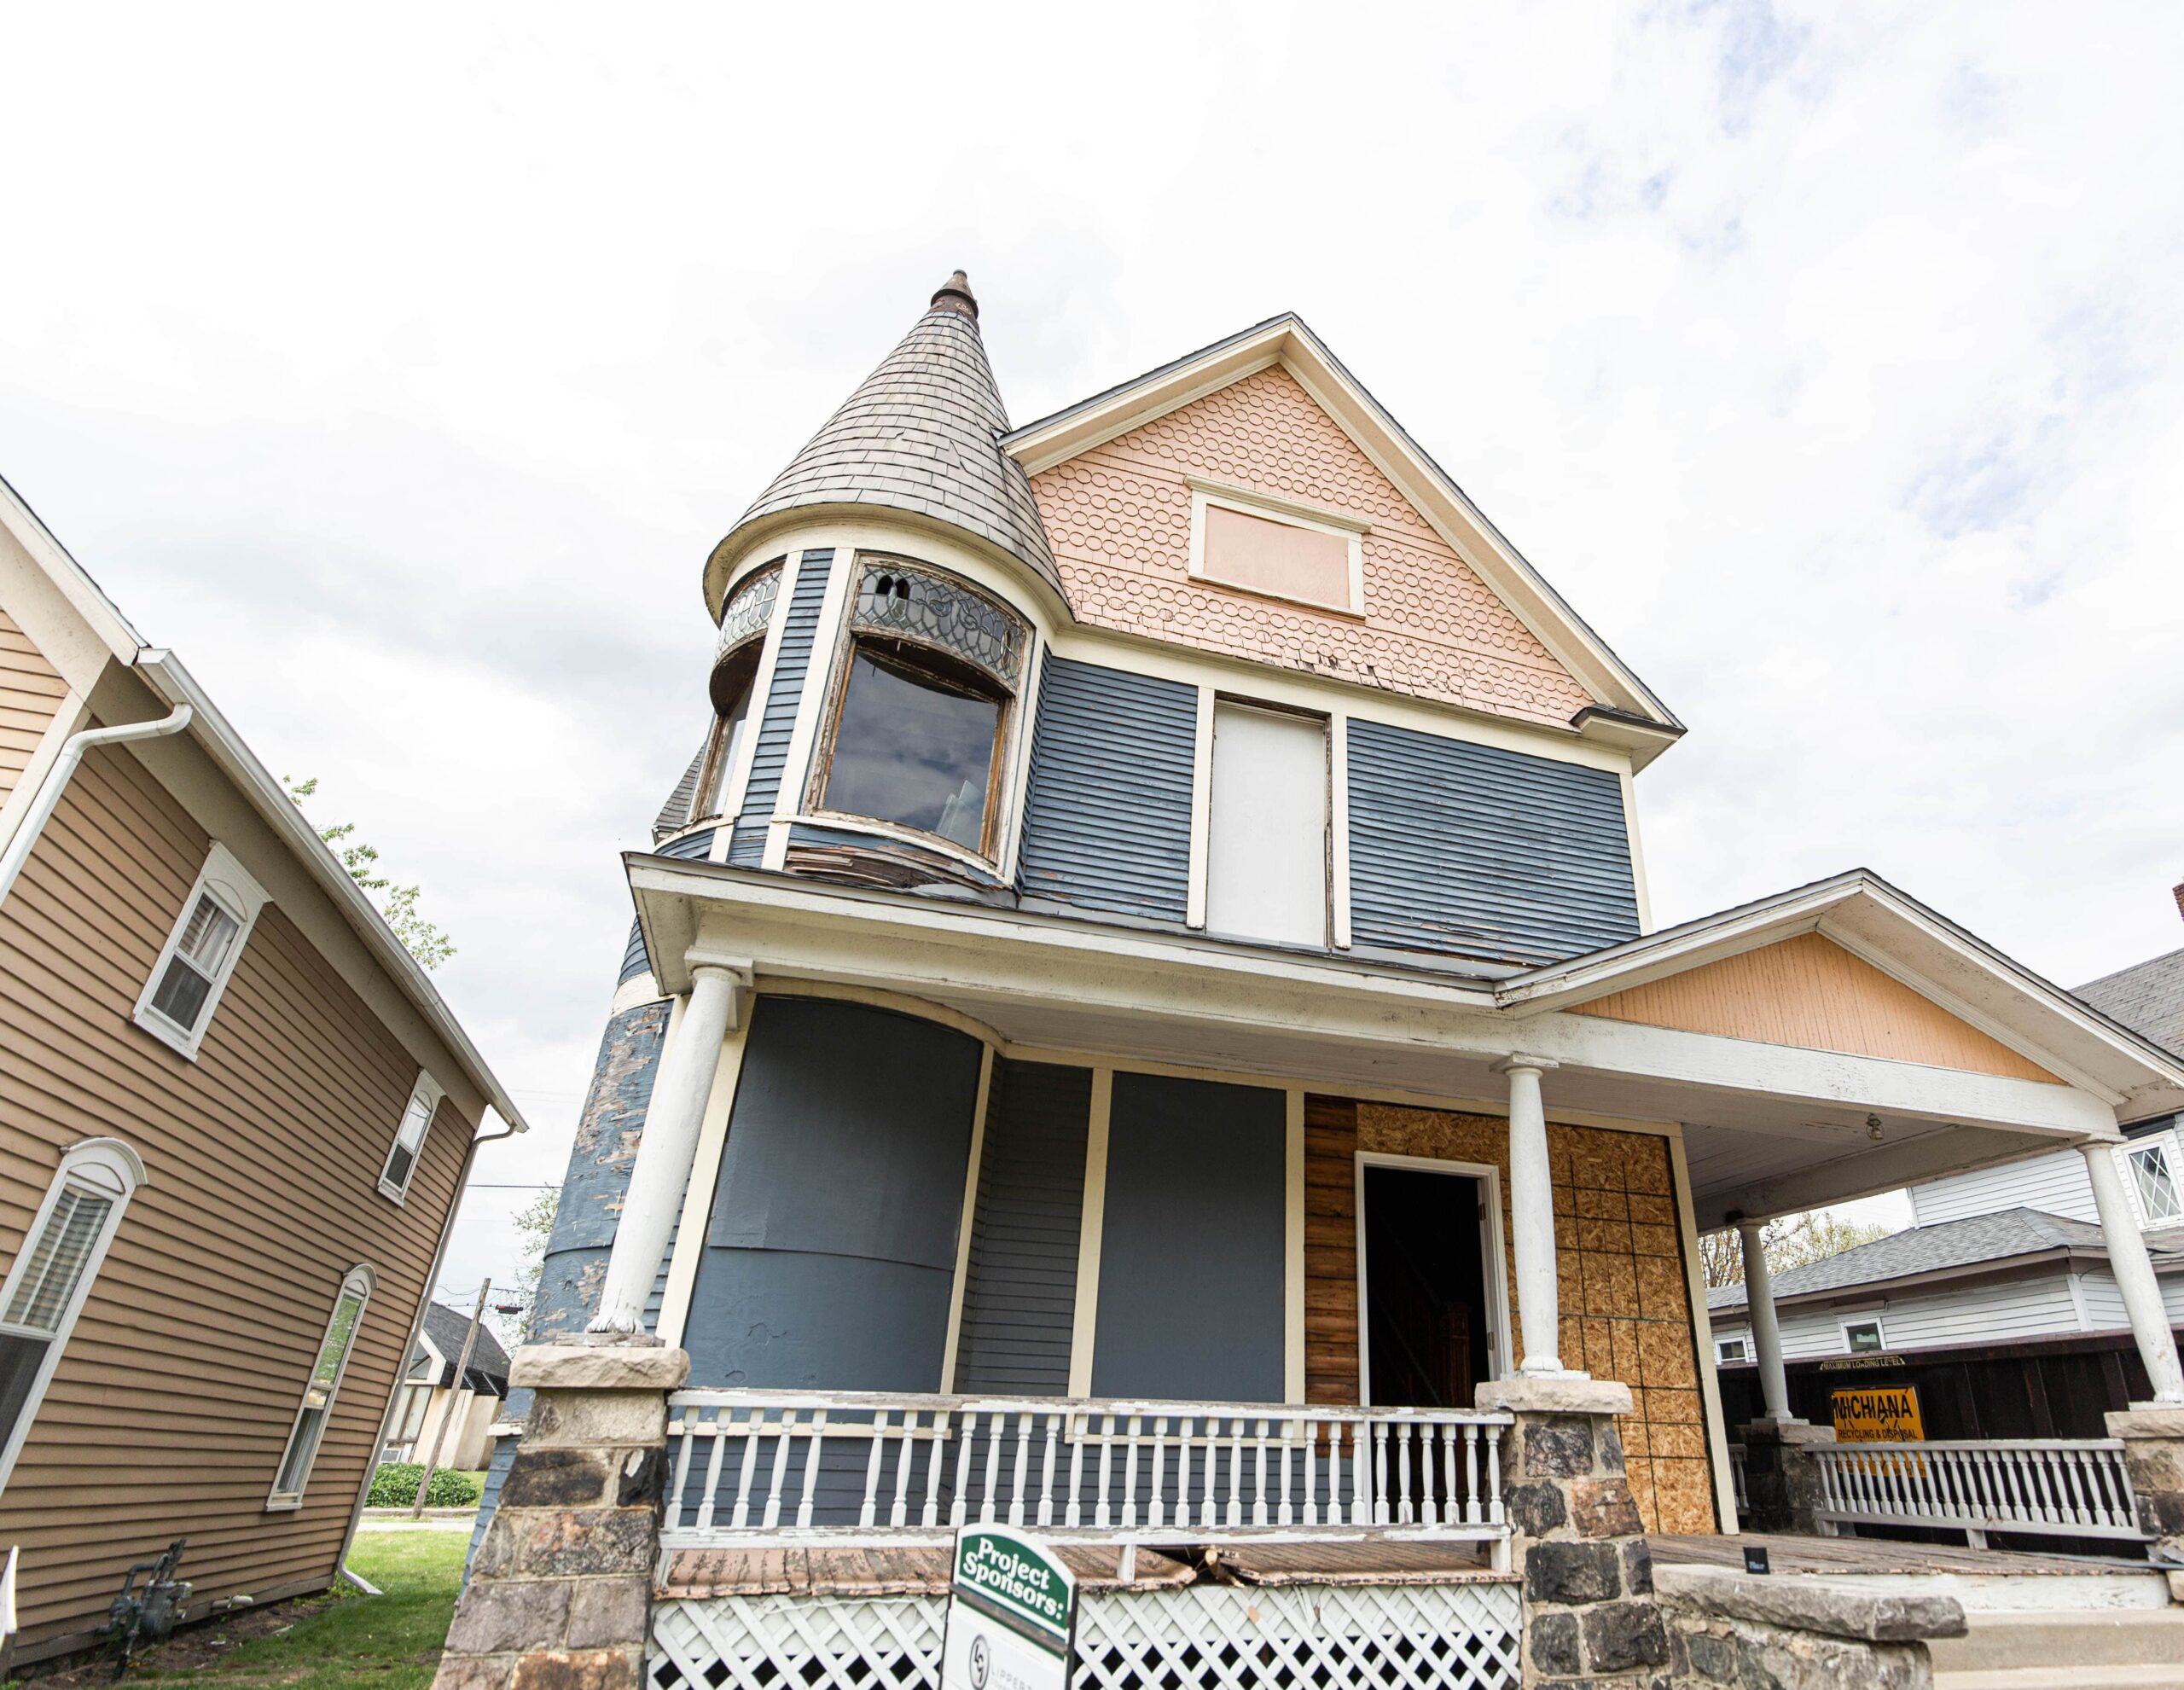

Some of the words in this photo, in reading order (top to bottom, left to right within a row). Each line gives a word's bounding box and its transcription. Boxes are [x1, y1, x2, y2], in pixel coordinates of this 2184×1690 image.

[1823, 1361, 1851, 1371] MAXIMUM
[1880, 1356, 1902, 1367] LEVEL
[1833, 1395, 1913, 1420] MICHIANA
[1838, 1429, 1874, 1440] RECYCLING
[1876, 1429, 1881, 1439] &
[1883, 1428, 1918, 1439] DISPOSAL
[979, 1537, 1050, 1590] Project
[963, 1552, 1064, 1620] Sponsors:
